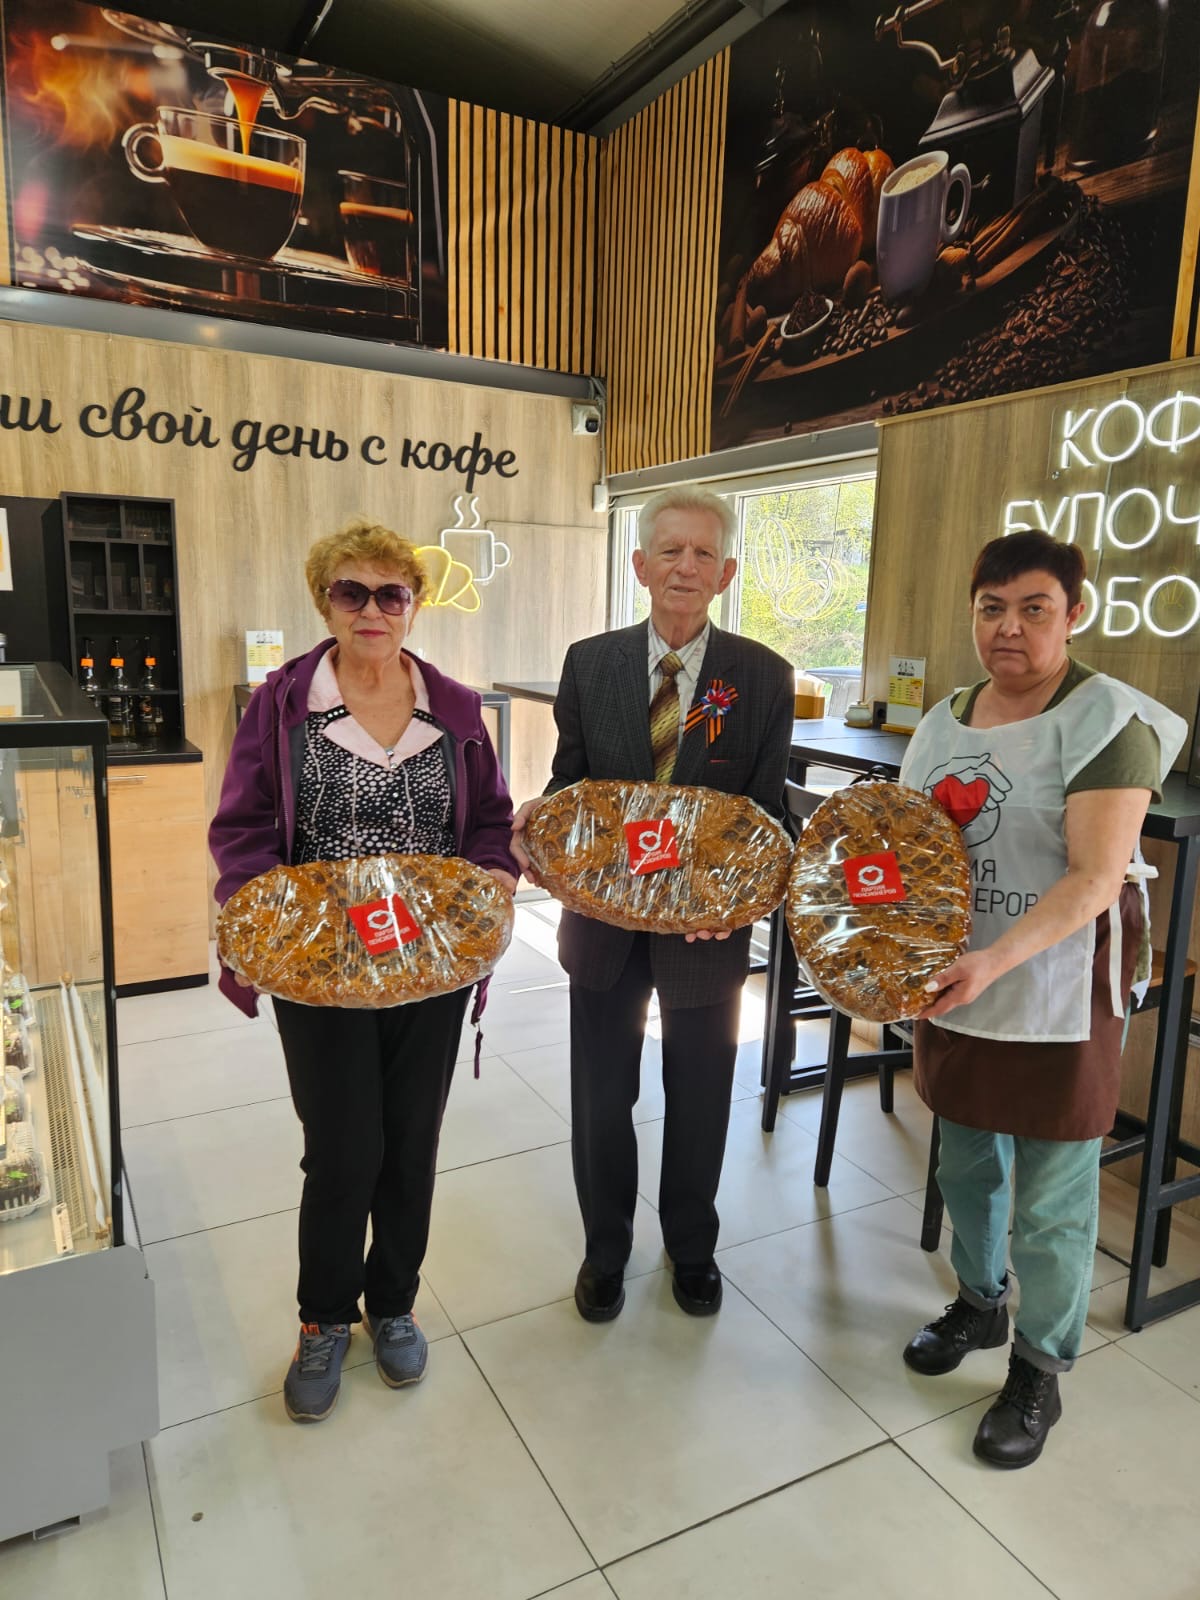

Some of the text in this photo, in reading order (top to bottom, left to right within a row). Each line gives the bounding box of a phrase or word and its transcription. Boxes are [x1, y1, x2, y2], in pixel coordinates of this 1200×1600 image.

[79, 387, 220, 449] свой
[231, 420, 349, 472] день
[361, 435, 387, 466] с
[400, 432, 519, 494] кофе
[1061, 390, 1200, 469] КОФ
